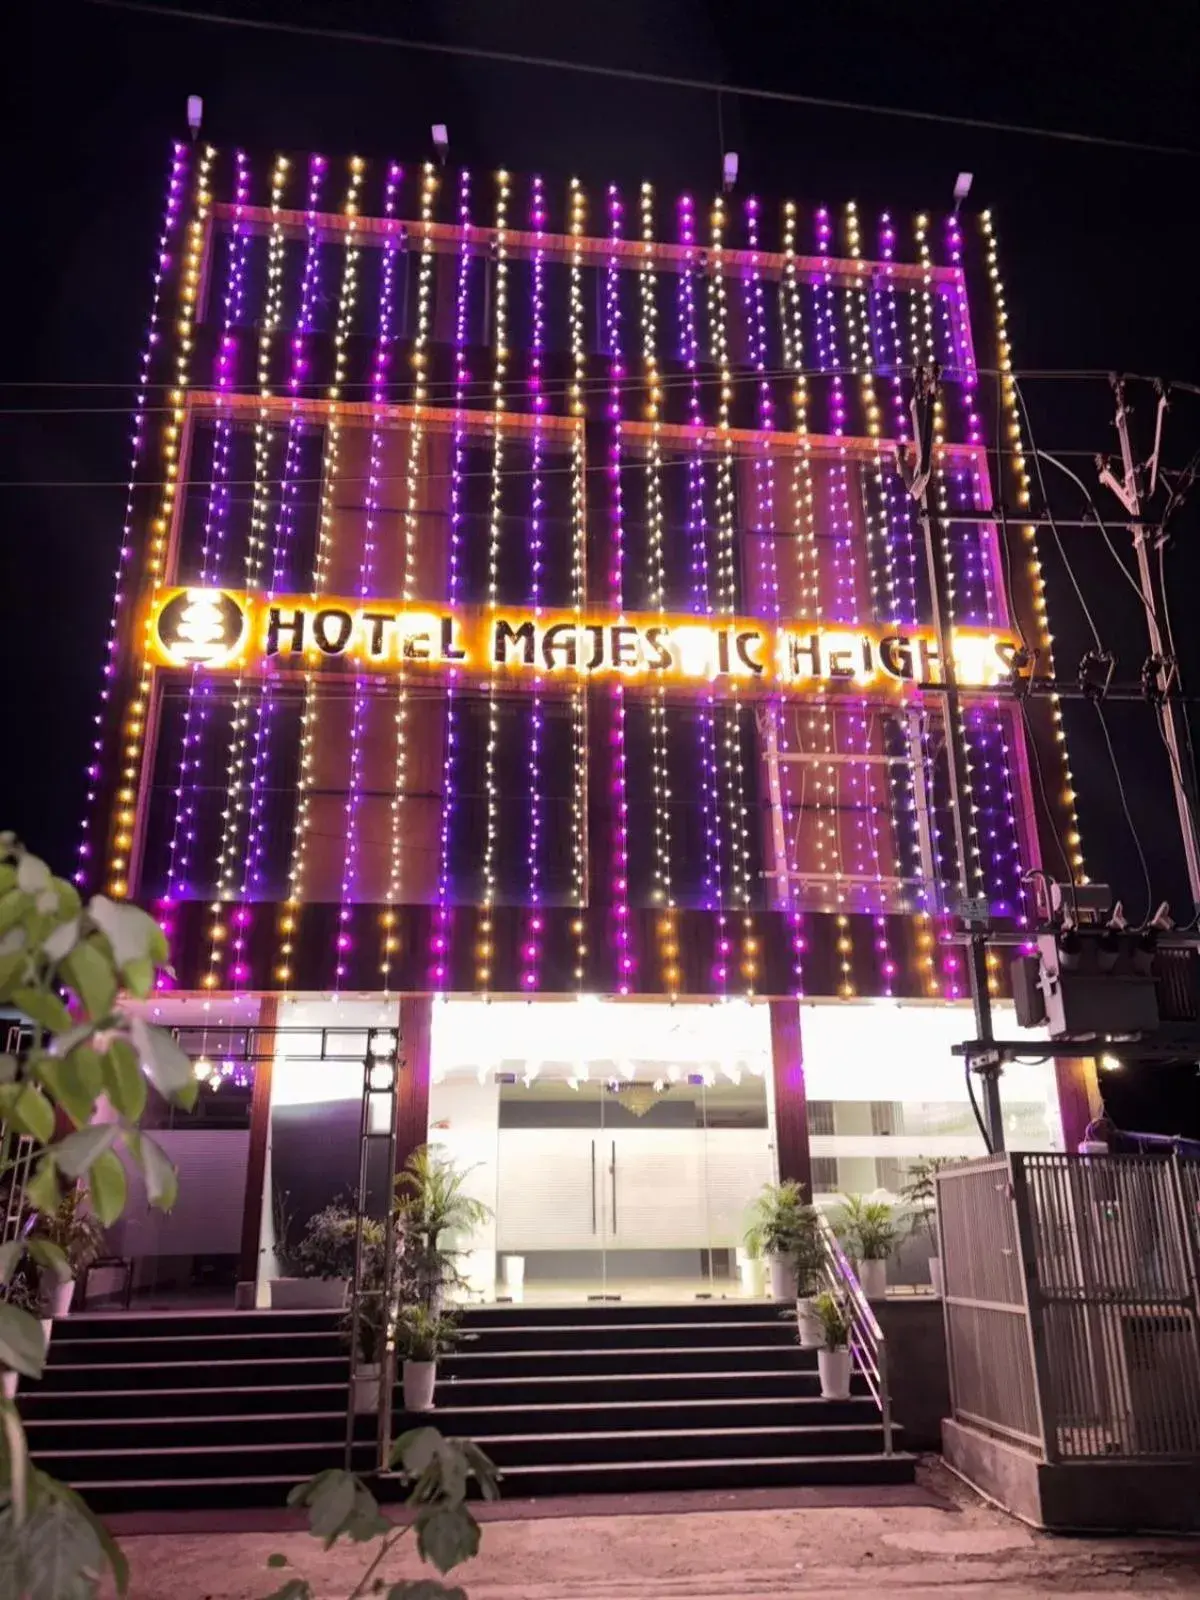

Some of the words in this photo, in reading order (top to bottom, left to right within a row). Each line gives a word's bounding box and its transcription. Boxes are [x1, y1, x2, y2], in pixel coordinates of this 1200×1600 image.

[266, 606, 466, 660] HOTEL
[494, 619, 763, 673] MAJESIC
[787, 634, 1019, 686] HEIGHS
